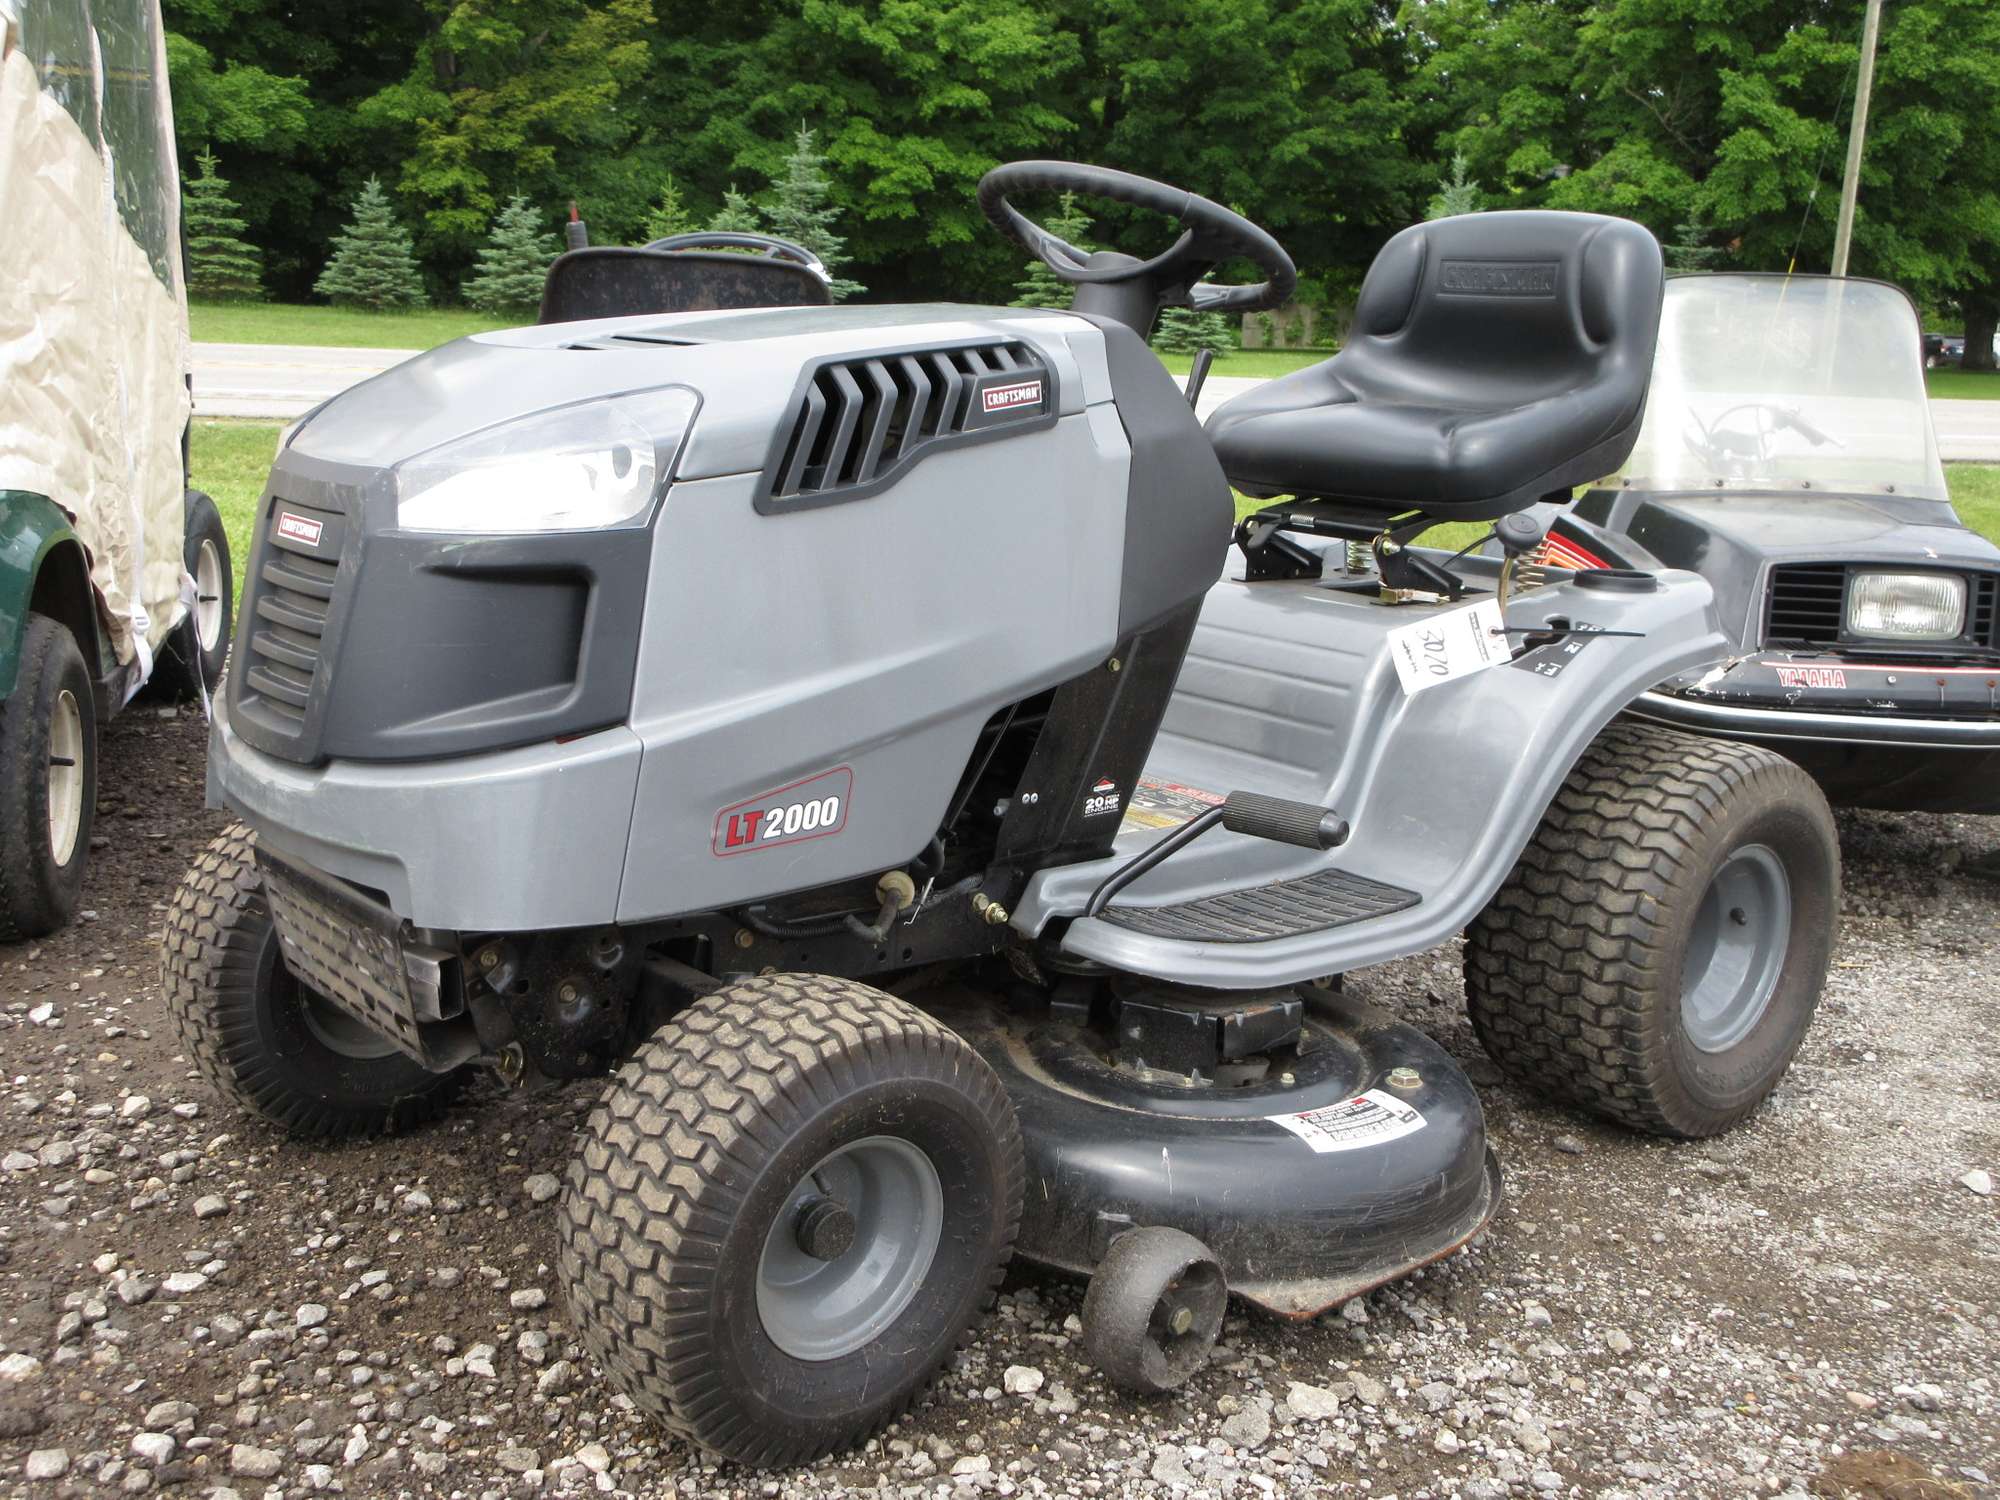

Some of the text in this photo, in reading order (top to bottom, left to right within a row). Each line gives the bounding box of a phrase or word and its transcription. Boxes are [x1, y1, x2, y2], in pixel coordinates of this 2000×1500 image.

[987, 387, 1037, 406] CRAFTSMAN
[1776, 667, 1847, 689] YAMAHA
[1085, 796, 1119, 810] 20 HP
